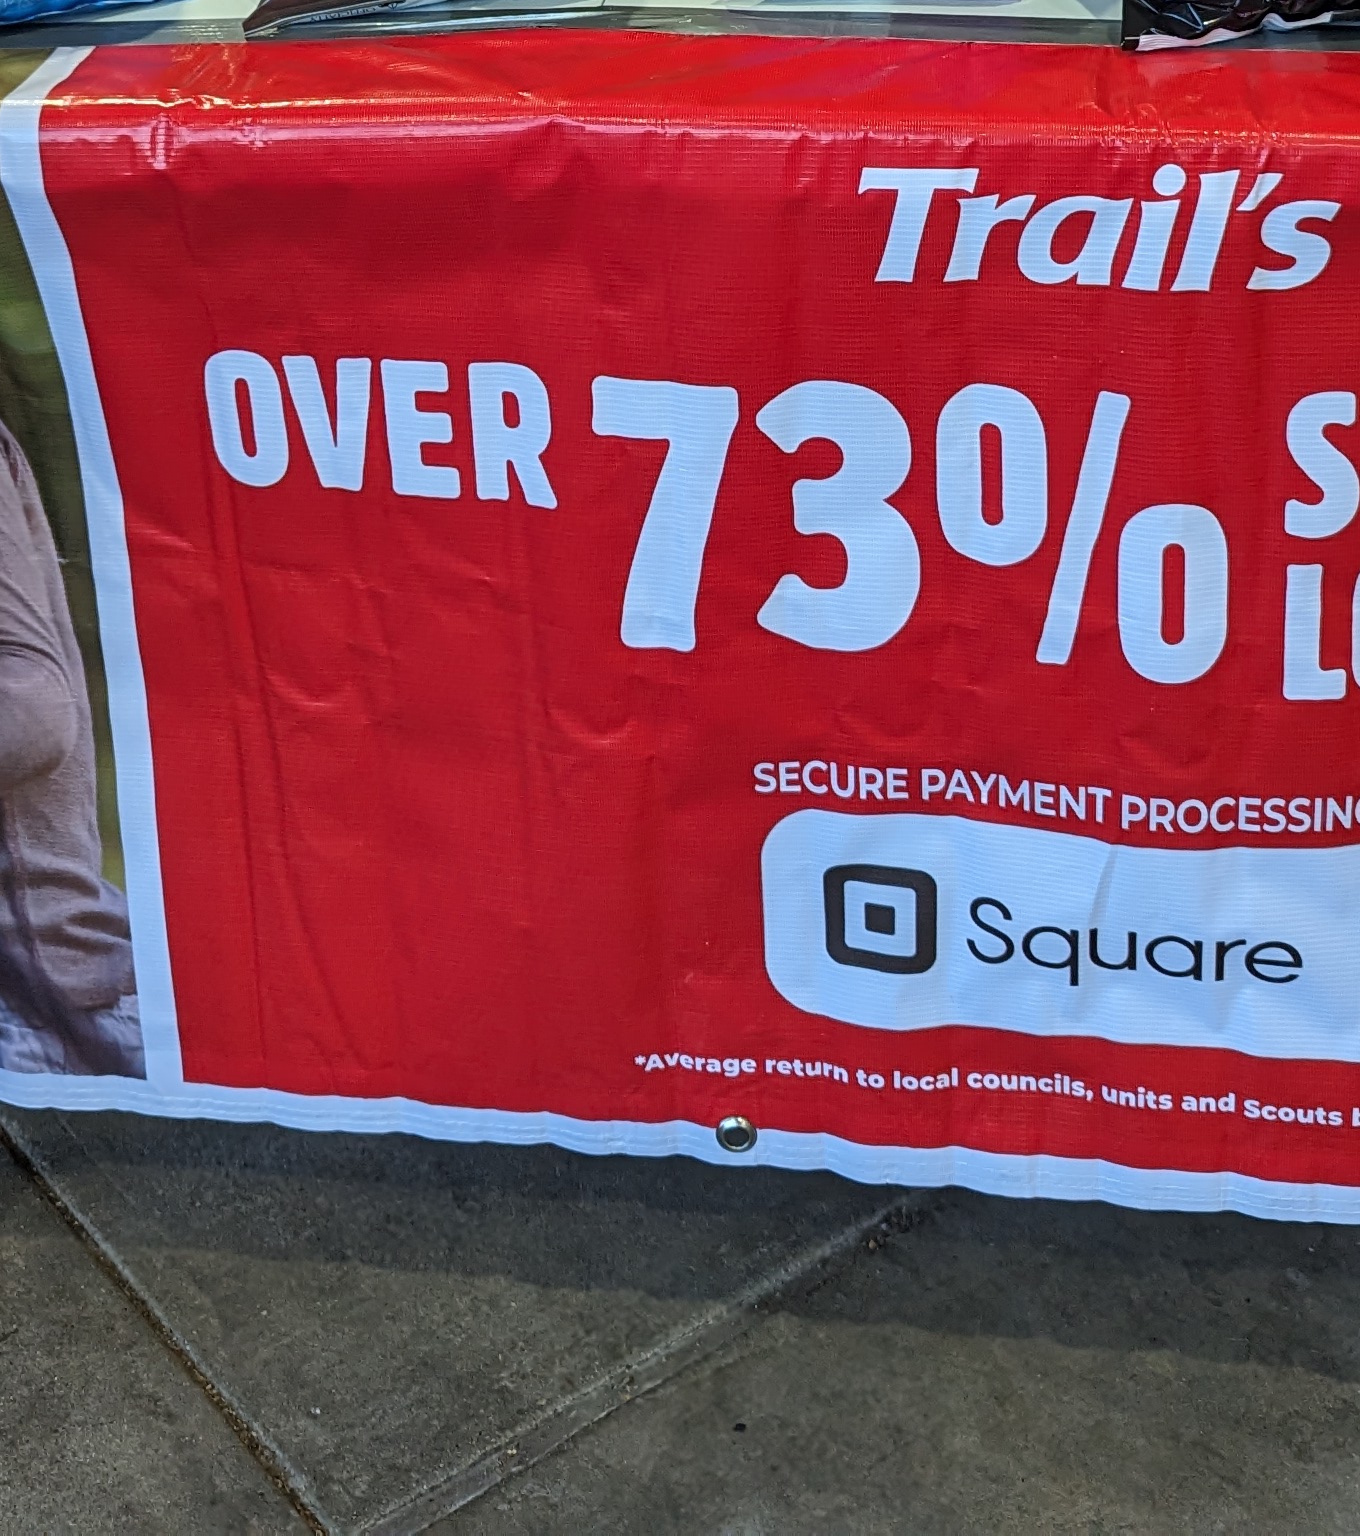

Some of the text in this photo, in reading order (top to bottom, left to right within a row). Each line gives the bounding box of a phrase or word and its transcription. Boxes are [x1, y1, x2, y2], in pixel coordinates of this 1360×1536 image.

[856, 162, 1335, 293] Trail's
[203, 349, 559, 510] OVER
[590, 374, 1229, 686] 73%
[753, 760, 909, 800] SECURE
[921, 768, 1112, 823] PAYMENT
[966, 895, 1303, 987] Square
[765, 1057, 849, 1085] return
[856, 1068, 885, 1089] to
[893, 1067, 959, 1092] local
[966, 1070, 1094, 1103] councils,
[1101, 1086, 1174, 1111] units
[1181, 1092, 1236, 1115] and
[1243, 1099, 1343, 1127] Scouts
